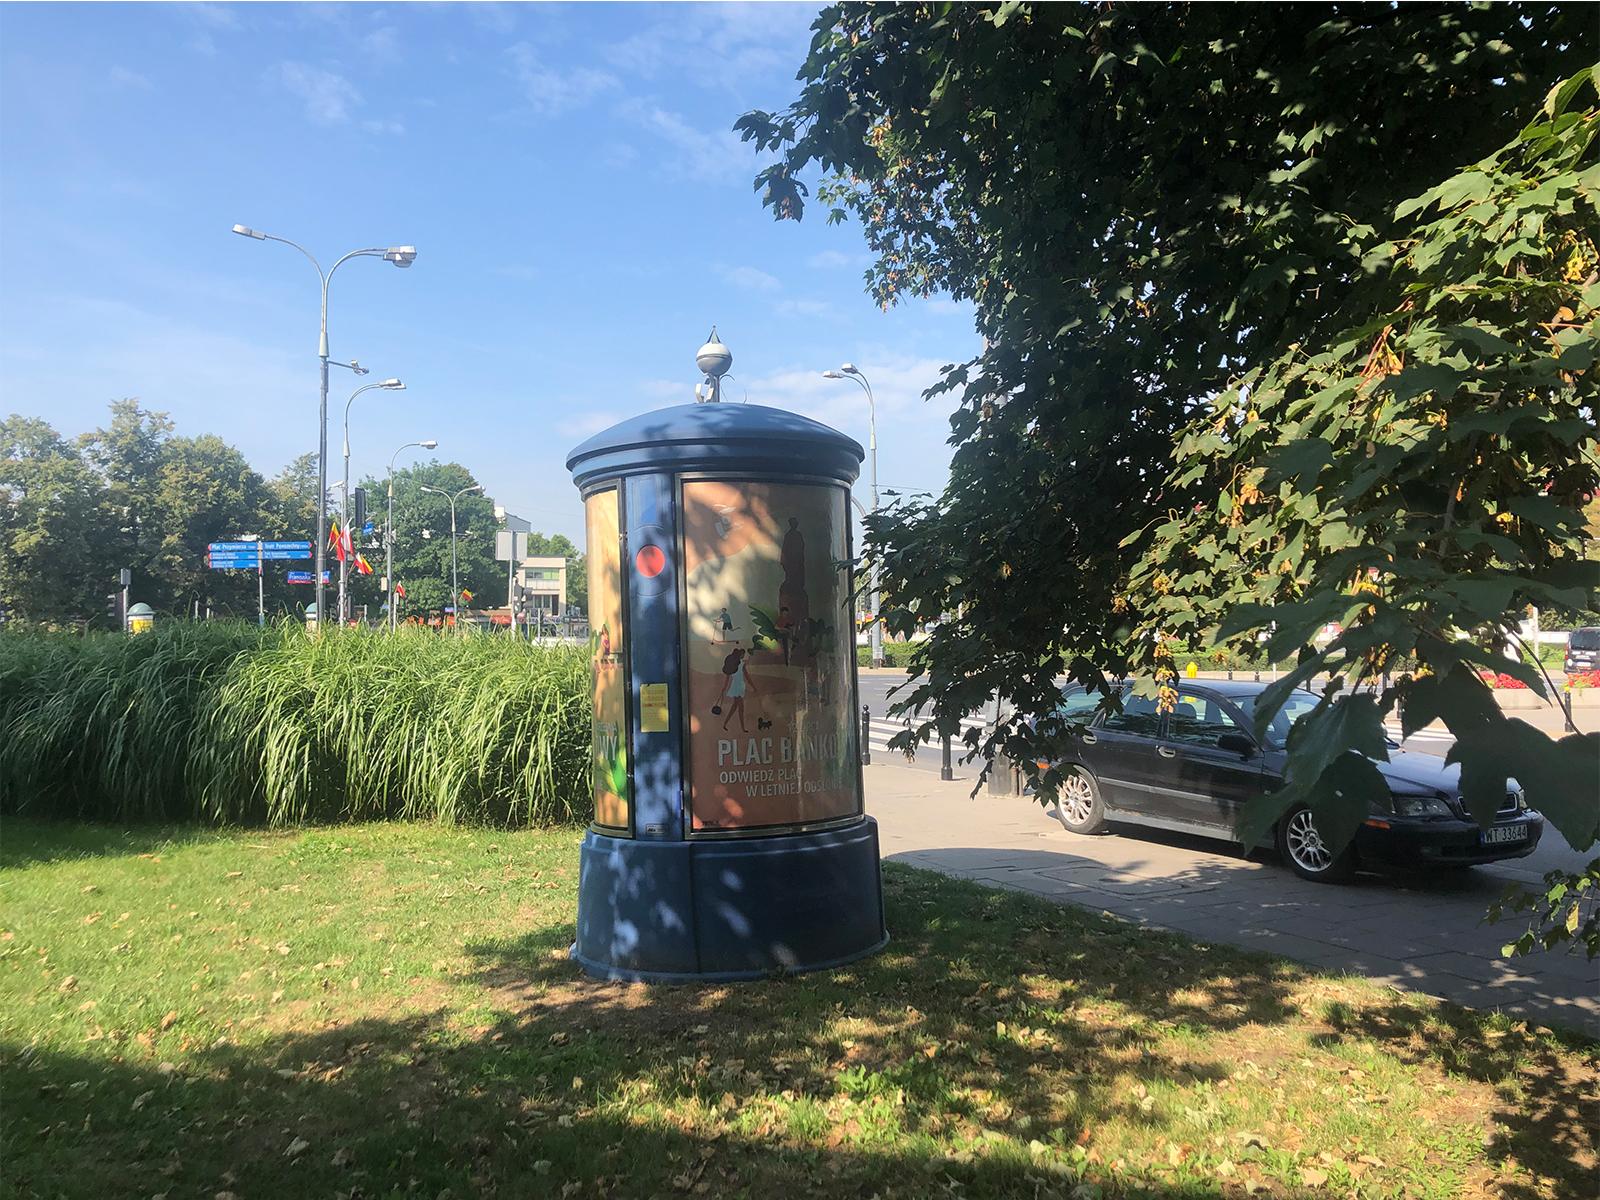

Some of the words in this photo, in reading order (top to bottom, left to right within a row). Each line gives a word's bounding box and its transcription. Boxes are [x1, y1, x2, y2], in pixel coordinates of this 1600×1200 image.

[718, 737, 773, 766] PLAC
[745, 785, 757, 797] W
[761, 782, 801, 797] LETNIEJ
